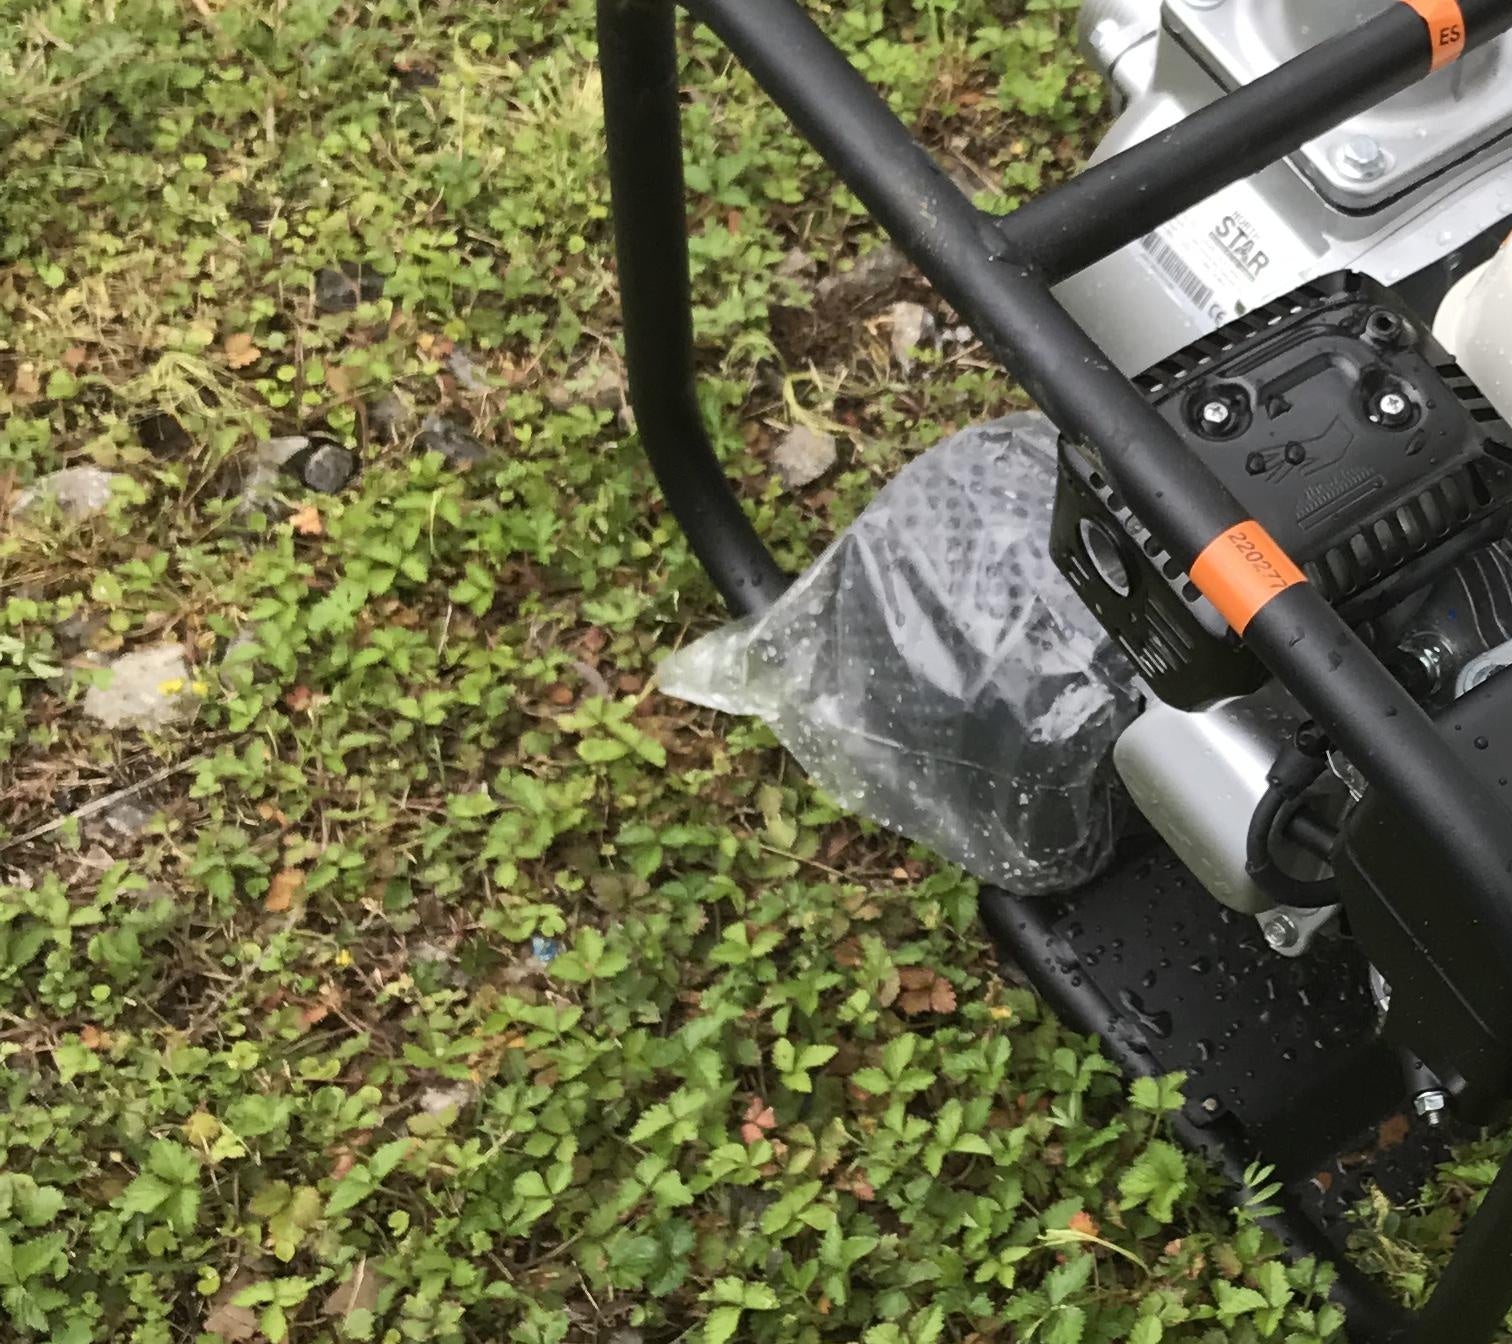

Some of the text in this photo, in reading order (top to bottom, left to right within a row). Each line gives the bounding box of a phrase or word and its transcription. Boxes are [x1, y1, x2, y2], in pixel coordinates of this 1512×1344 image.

[1439, 24, 1461, 46] ES
[1215, 215, 1270, 277] STAR
[1228, 532, 1288, 589] 220277
